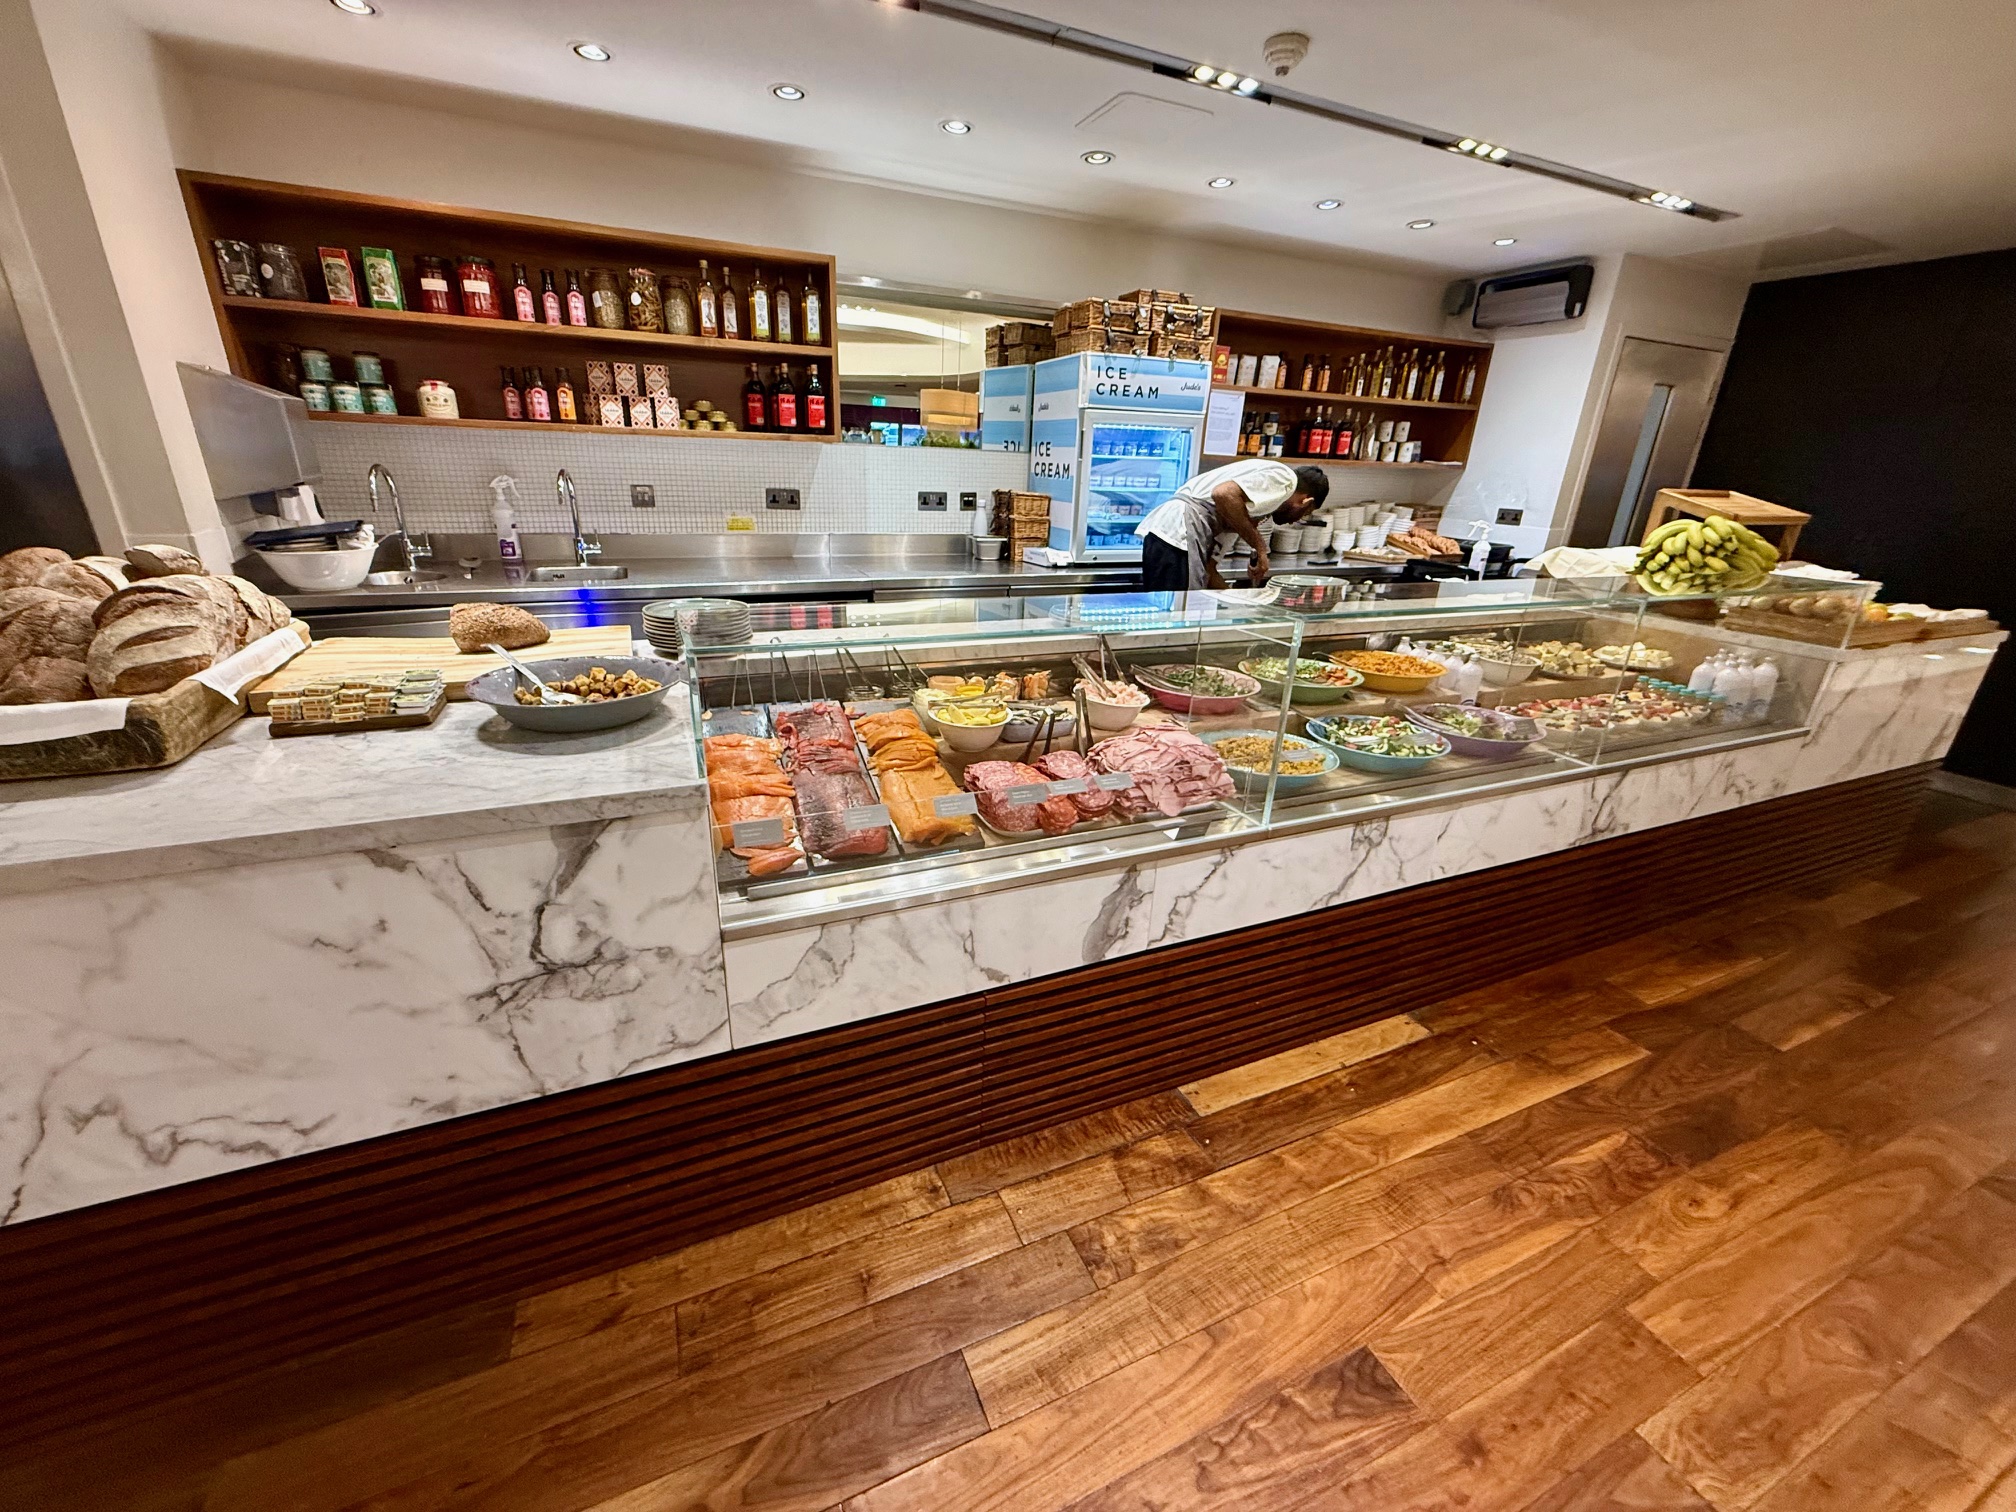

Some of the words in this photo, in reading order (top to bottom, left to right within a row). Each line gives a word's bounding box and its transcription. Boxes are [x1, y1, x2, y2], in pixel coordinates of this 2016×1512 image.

[1097, 366, 1127, 380] ICE
[1096, 383, 1160, 399] CREAM
[1034, 441, 1052, 457] ICE
[1034, 462, 1071, 480] CREAM
